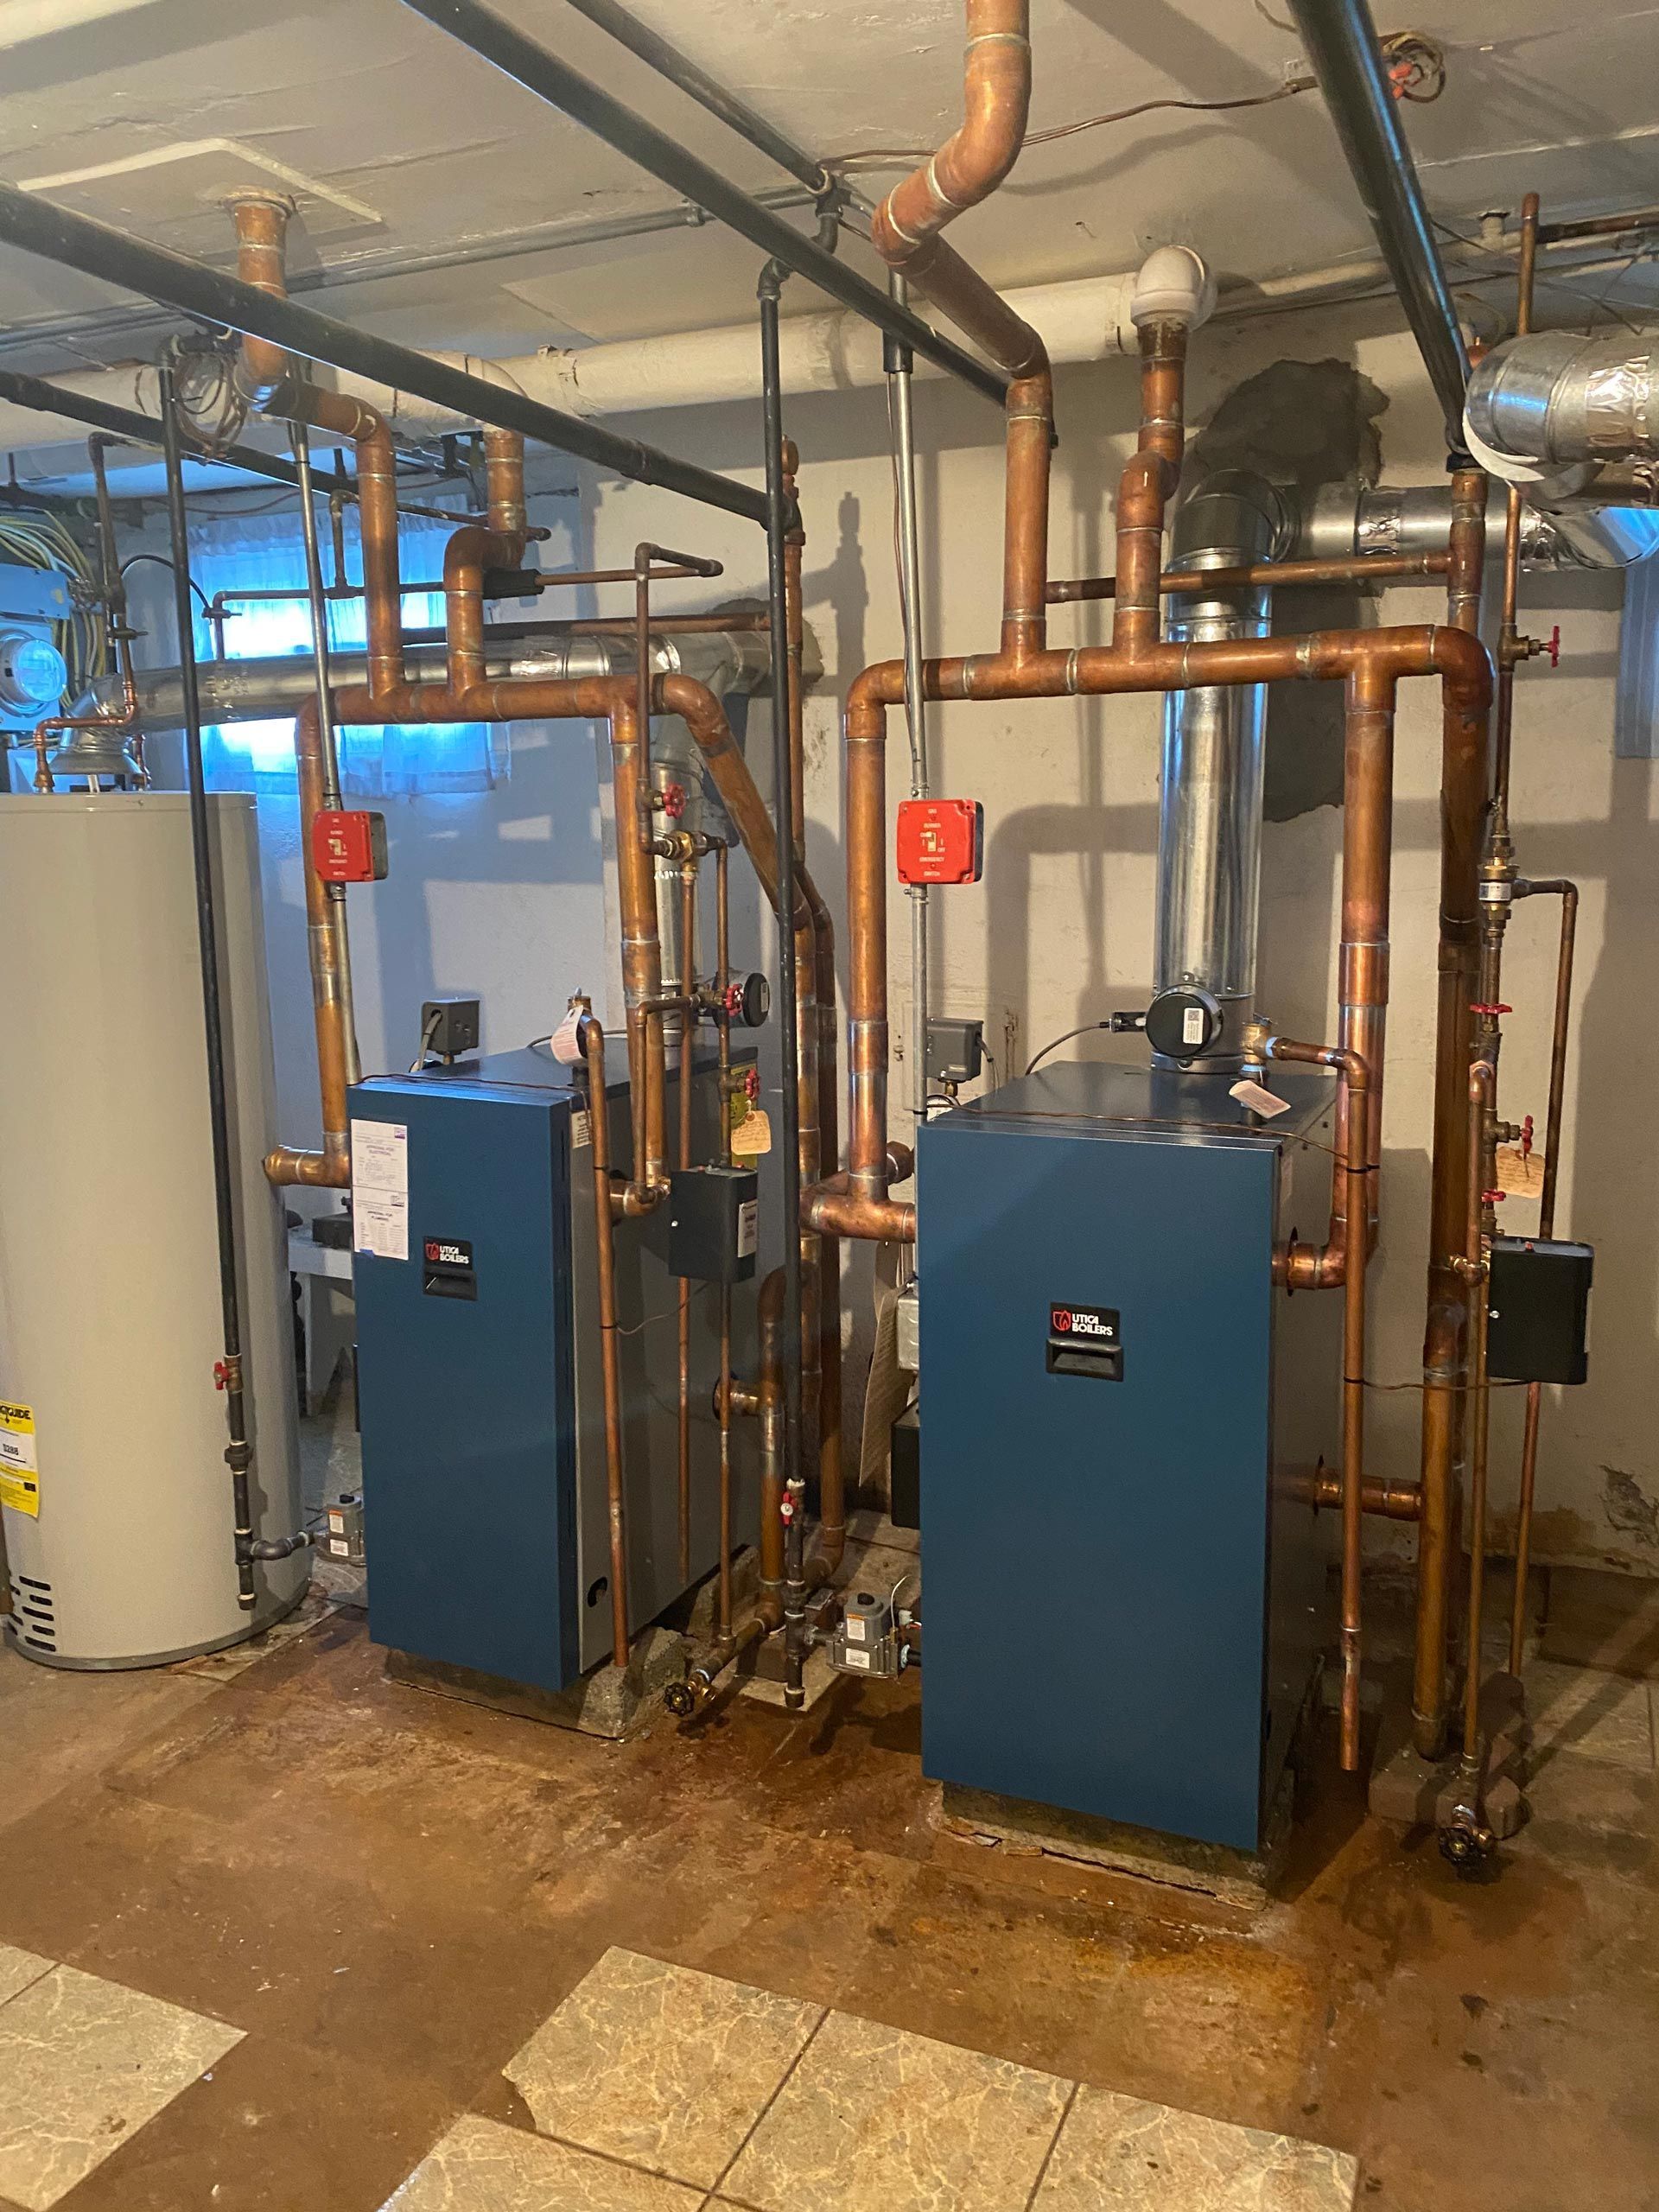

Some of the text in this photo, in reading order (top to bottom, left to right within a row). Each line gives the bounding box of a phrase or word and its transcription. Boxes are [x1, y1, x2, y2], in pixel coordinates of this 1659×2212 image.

[440, 1253, 469, 1264] BOILERS
[1071, 1313, 1099, 1325] UTICA
[1071, 1322, 1113, 1336] BOILERS
